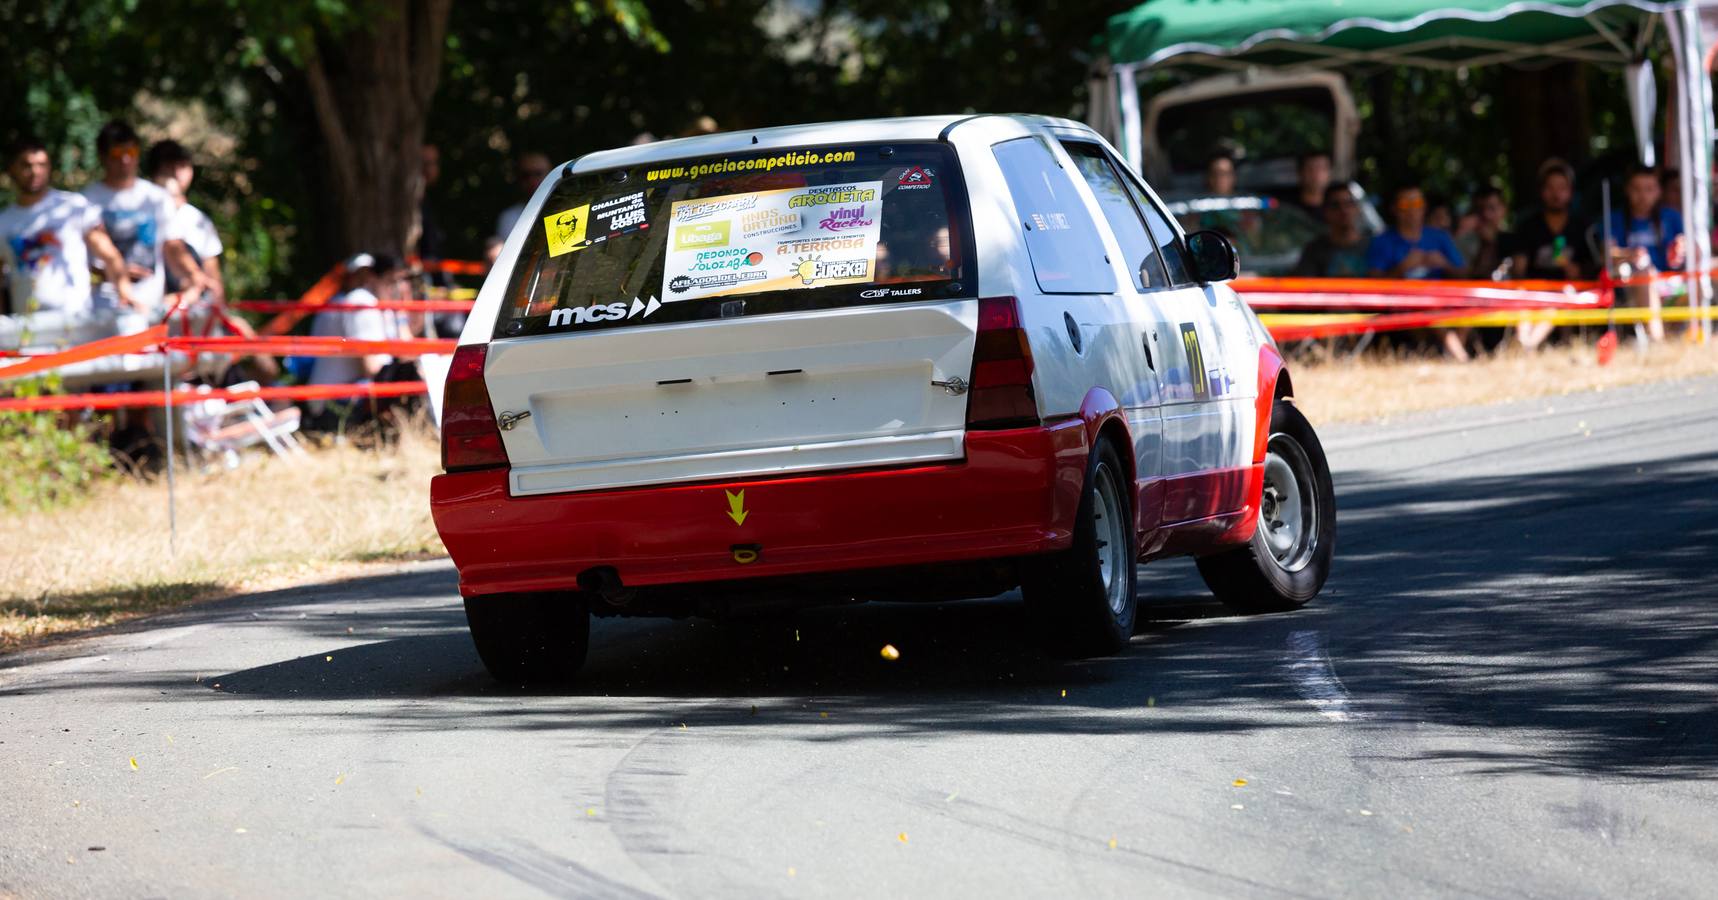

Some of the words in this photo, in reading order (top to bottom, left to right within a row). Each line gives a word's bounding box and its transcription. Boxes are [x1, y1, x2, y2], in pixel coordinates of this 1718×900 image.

[647, 151, 855, 180] www.garciacompeticio.com
[809, 186, 856, 195] DESATASCOS
[591, 191, 644, 211] CHALLENGE
[789, 189, 875, 209] ARQUETA
[596, 203, 645, 220] MUNTANYA
[742, 208, 779, 223] HNOS
[830, 204, 865, 220] vinyl
[610, 216, 646, 231] COSTA
[819, 218, 873, 232] Racers
[743, 224, 798, 239] CONSTRUCCIONES
[696, 248, 748, 263] REDONDO
[720, 273, 738, 283] DEL
[891, 288, 922, 296] TALLERS
[548, 302, 627, 327] mcs
